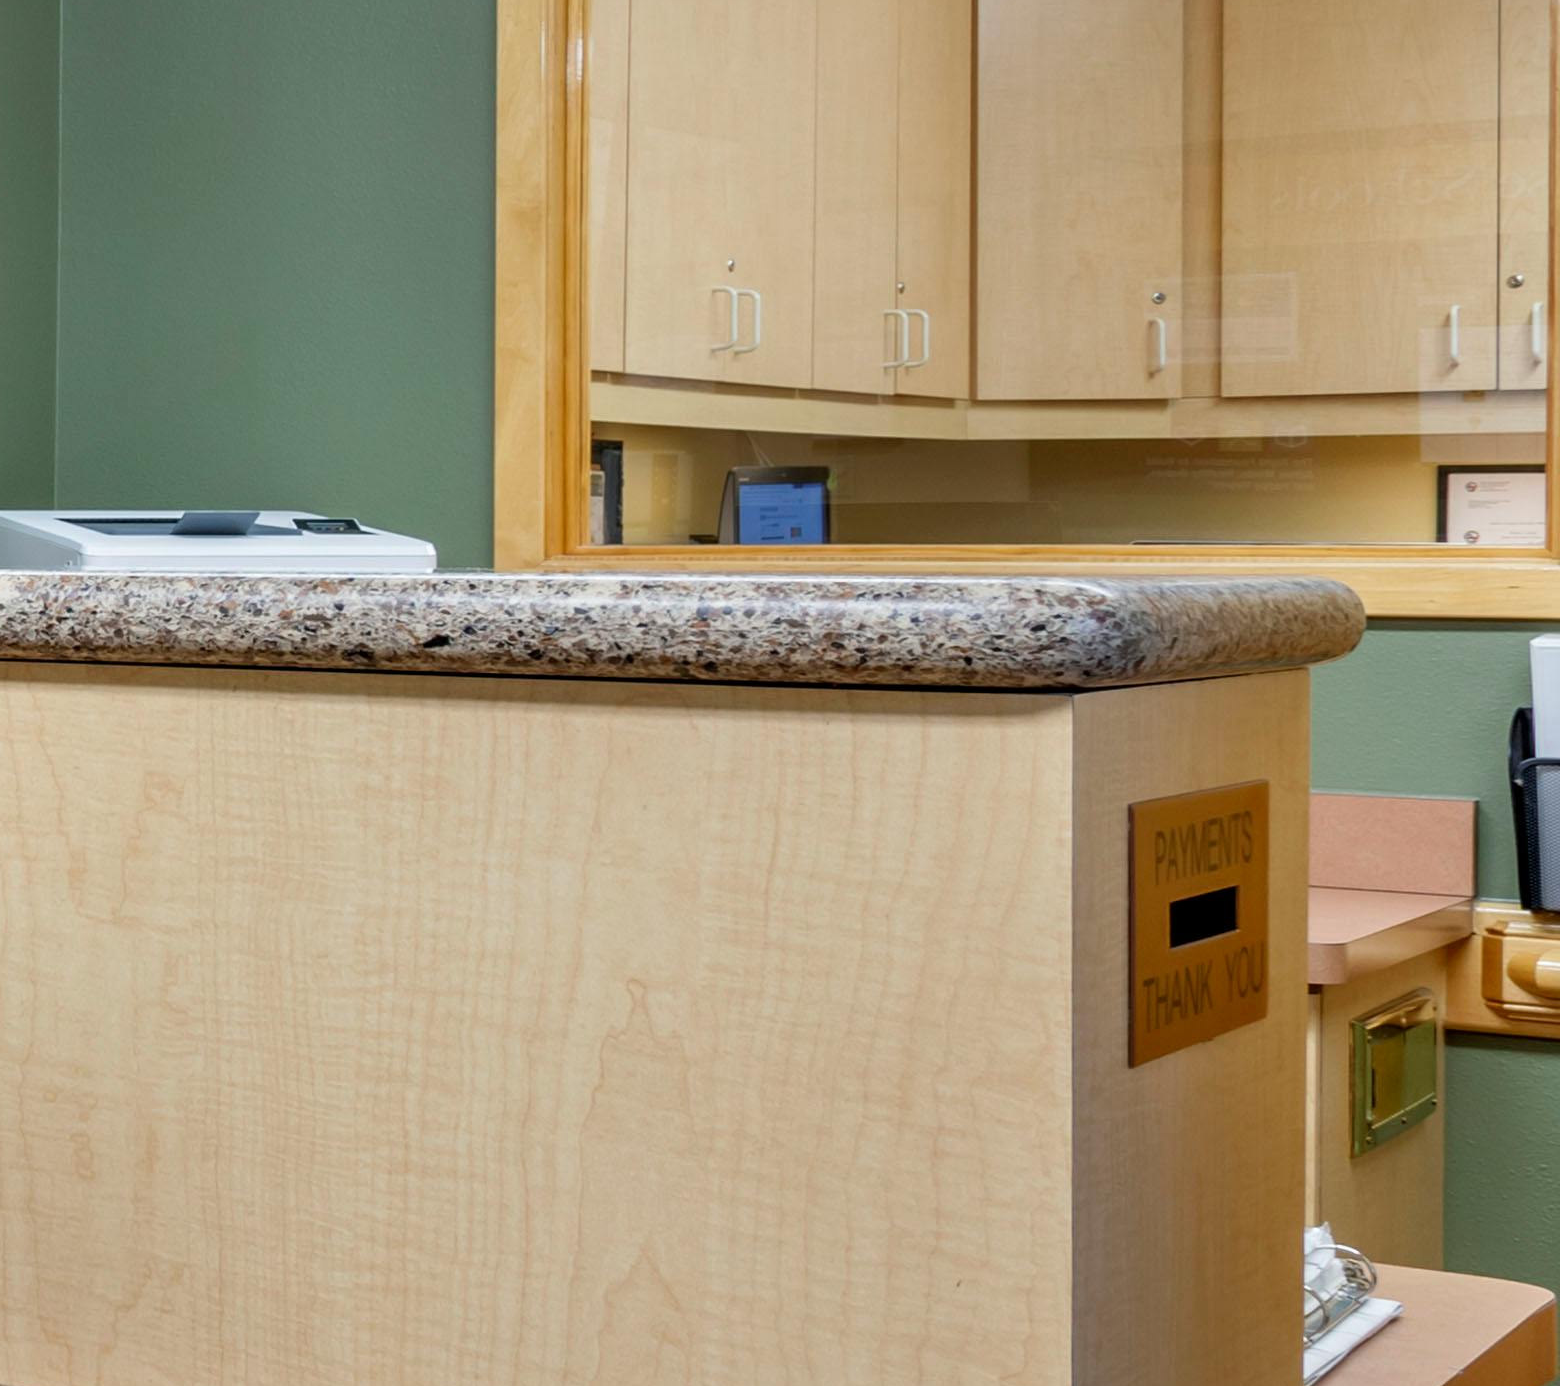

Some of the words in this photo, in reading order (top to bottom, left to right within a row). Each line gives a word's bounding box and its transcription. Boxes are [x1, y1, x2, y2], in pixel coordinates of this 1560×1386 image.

[1154, 810, 1253, 886] PAYMENTS
[1143, 959, 1214, 1033] THANK
[1225, 941, 1265, 1002] YOU
